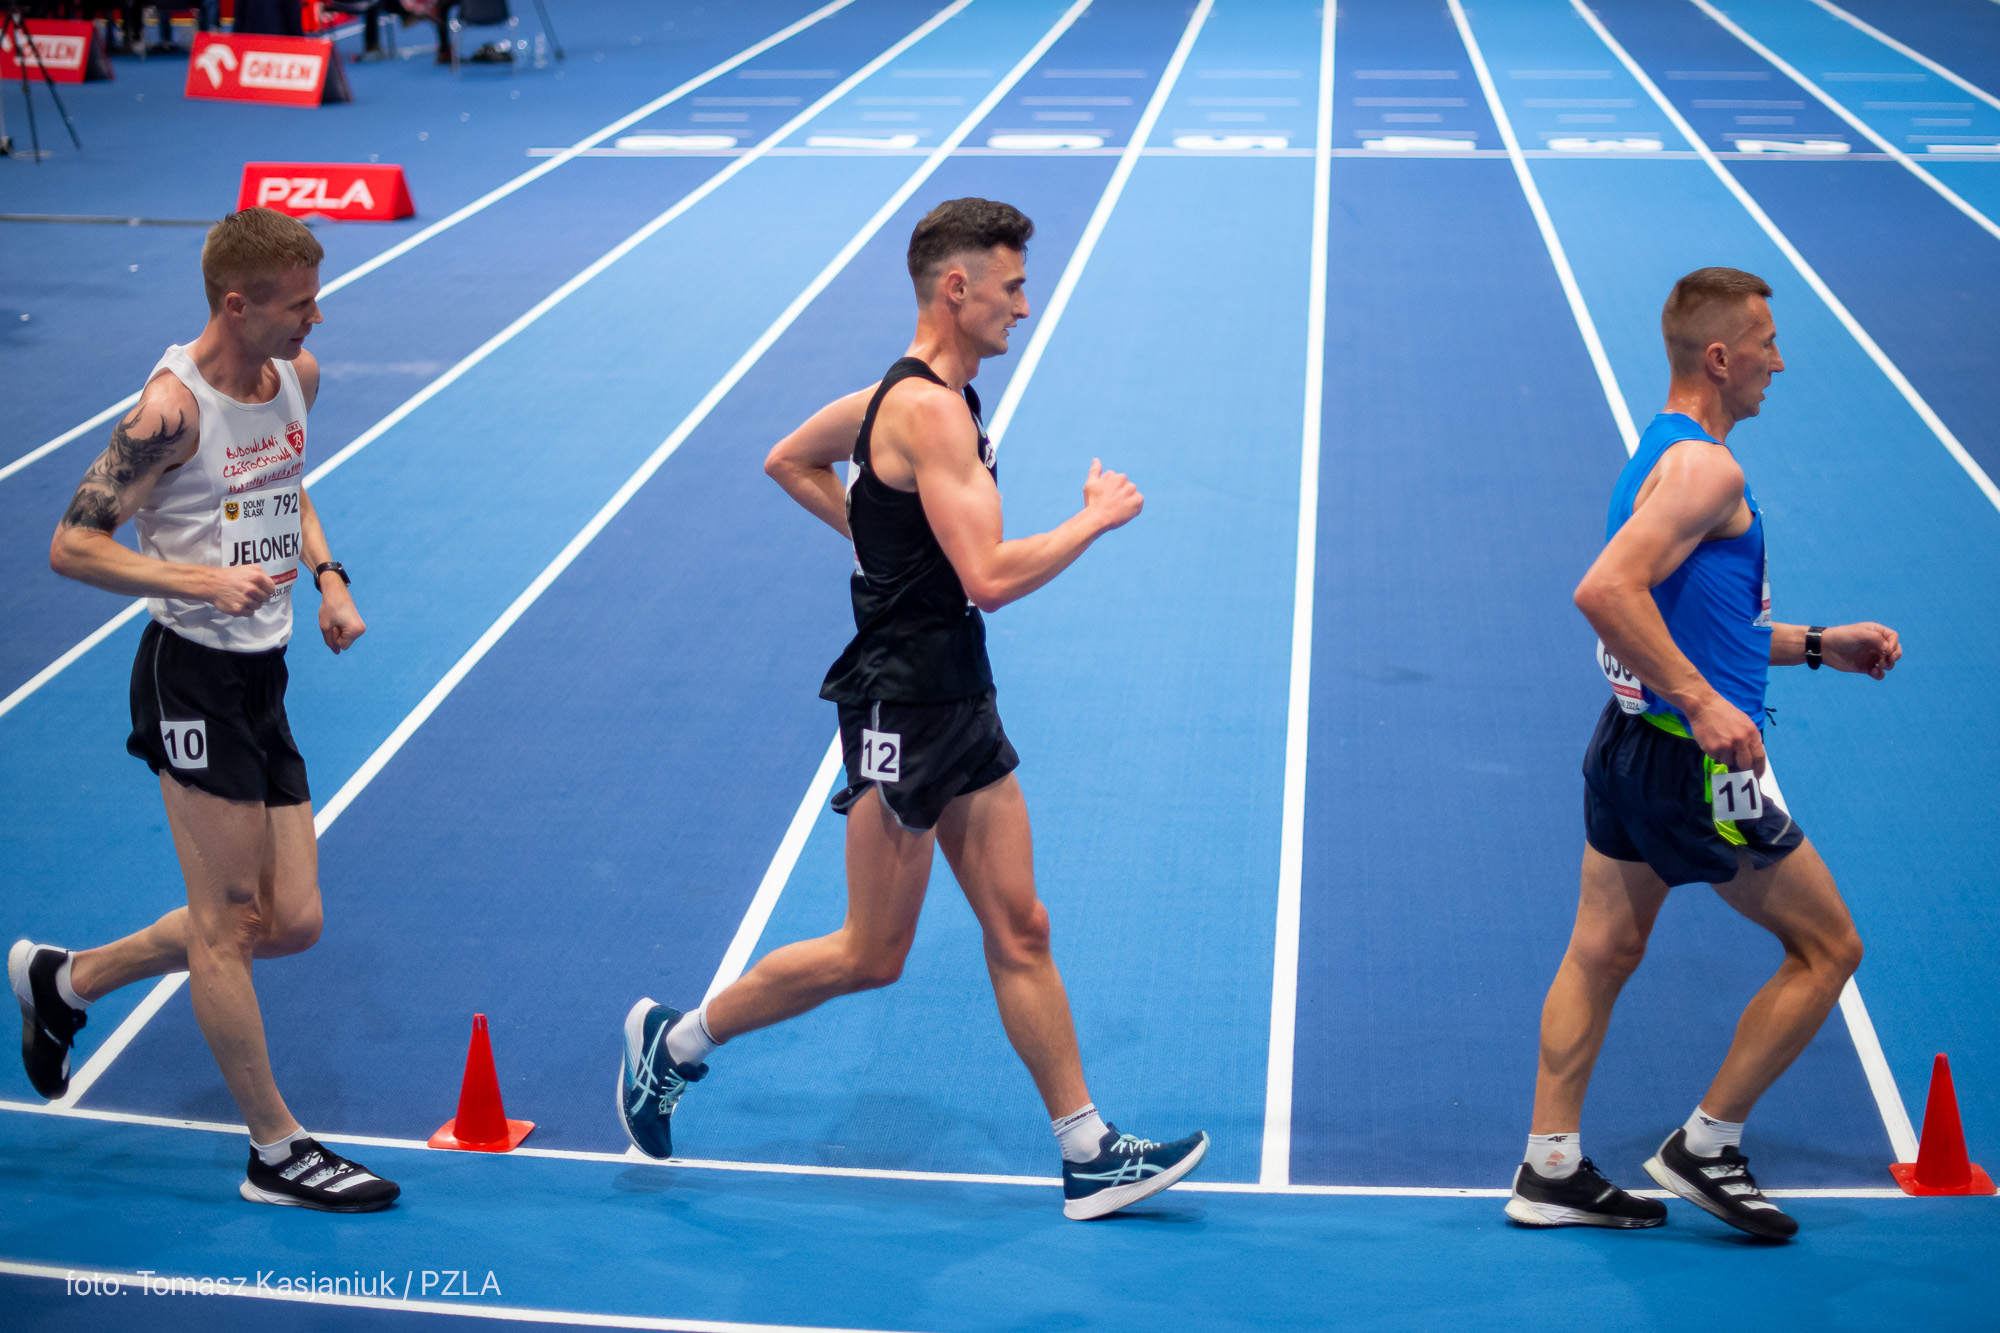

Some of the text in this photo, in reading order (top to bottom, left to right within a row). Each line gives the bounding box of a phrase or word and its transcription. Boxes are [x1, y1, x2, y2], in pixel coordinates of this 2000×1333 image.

[248, 59, 312, 81] ORLEN
[257, 177, 375, 210] PZLA
[243, 499, 265, 510] DOLNY
[273, 492, 298, 516] 792
[229, 531, 300, 567] JELONEK
[164, 728, 205, 761] 10
[864, 738, 897, 774] 12
[1718, 777, 1757, 813] 11
